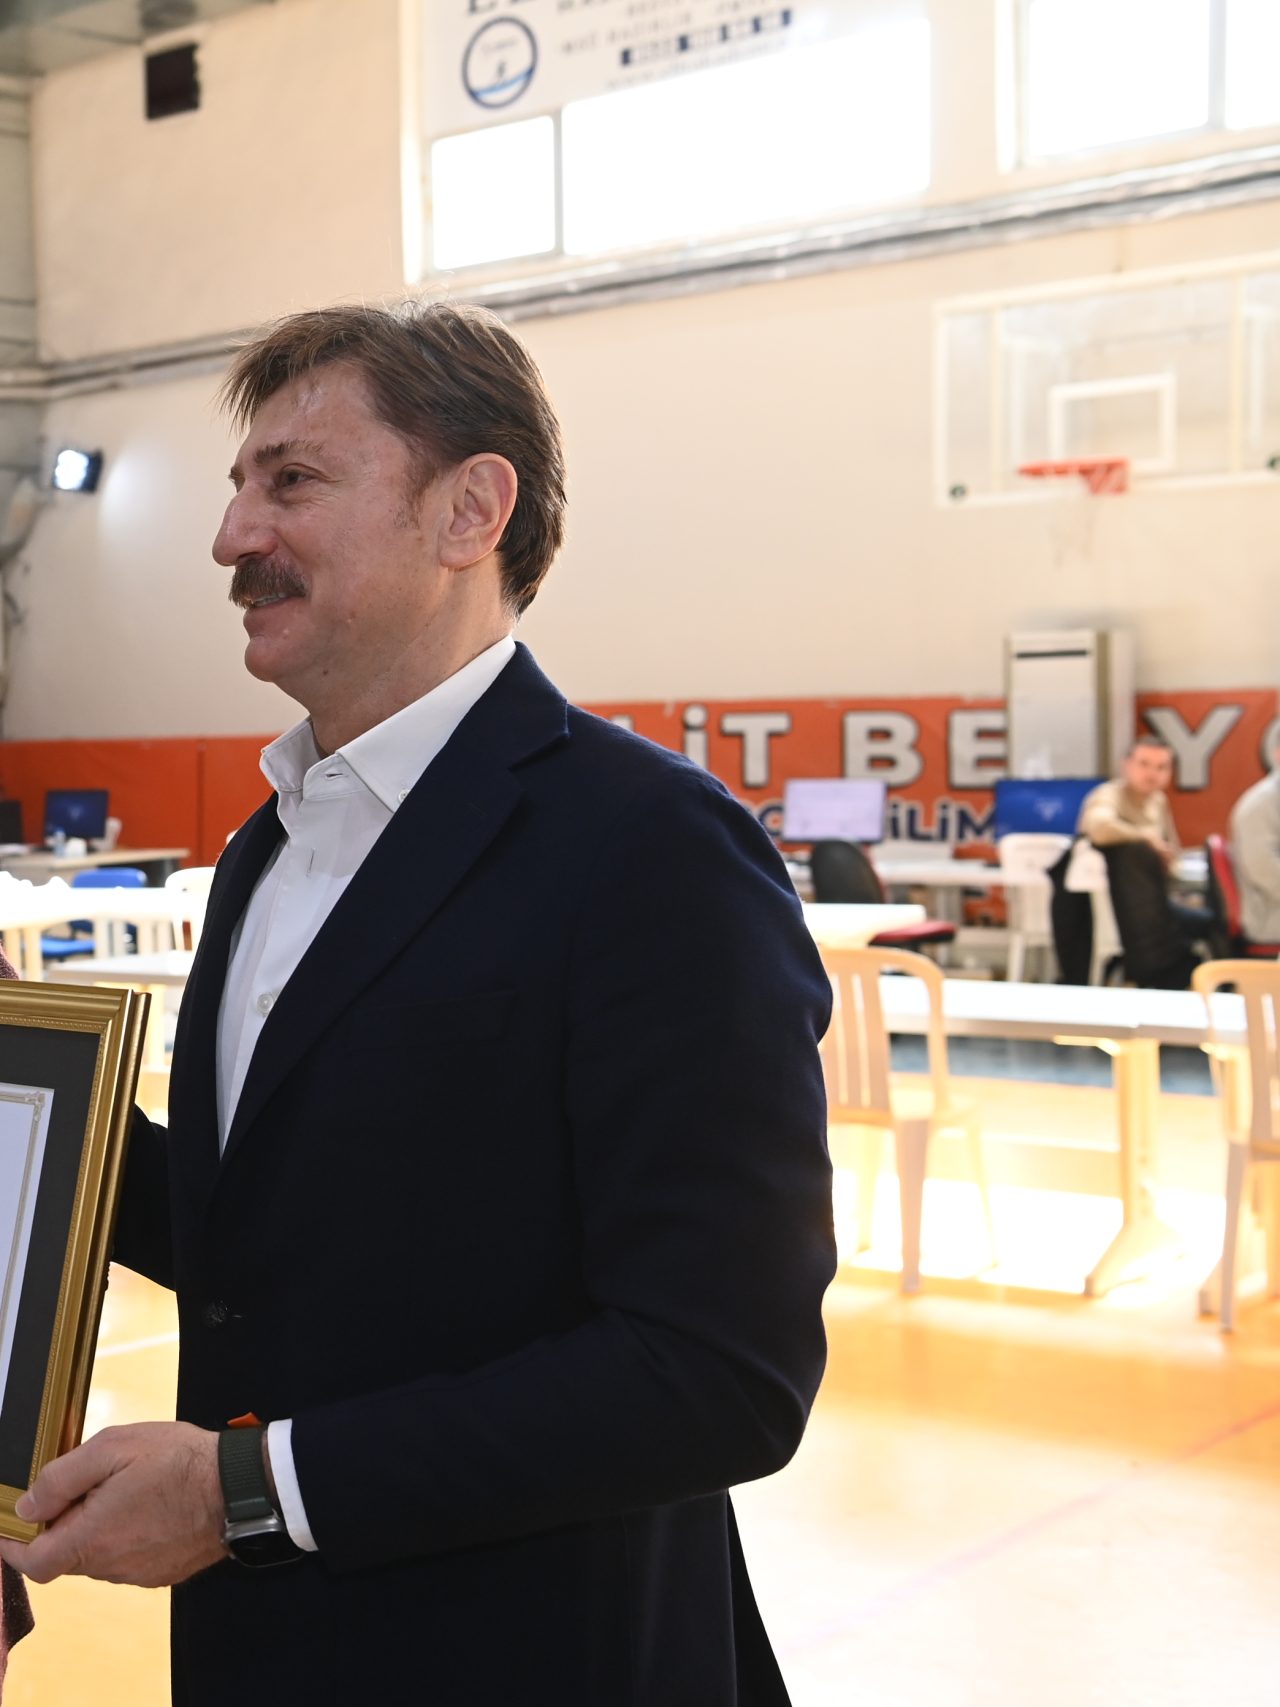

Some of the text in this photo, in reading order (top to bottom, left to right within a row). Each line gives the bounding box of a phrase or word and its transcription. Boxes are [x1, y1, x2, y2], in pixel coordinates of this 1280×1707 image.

[612, 702, 792, 789] iT
[841, 708, 1009, 790] BE
[888, 802, 996, 842] iLiM
